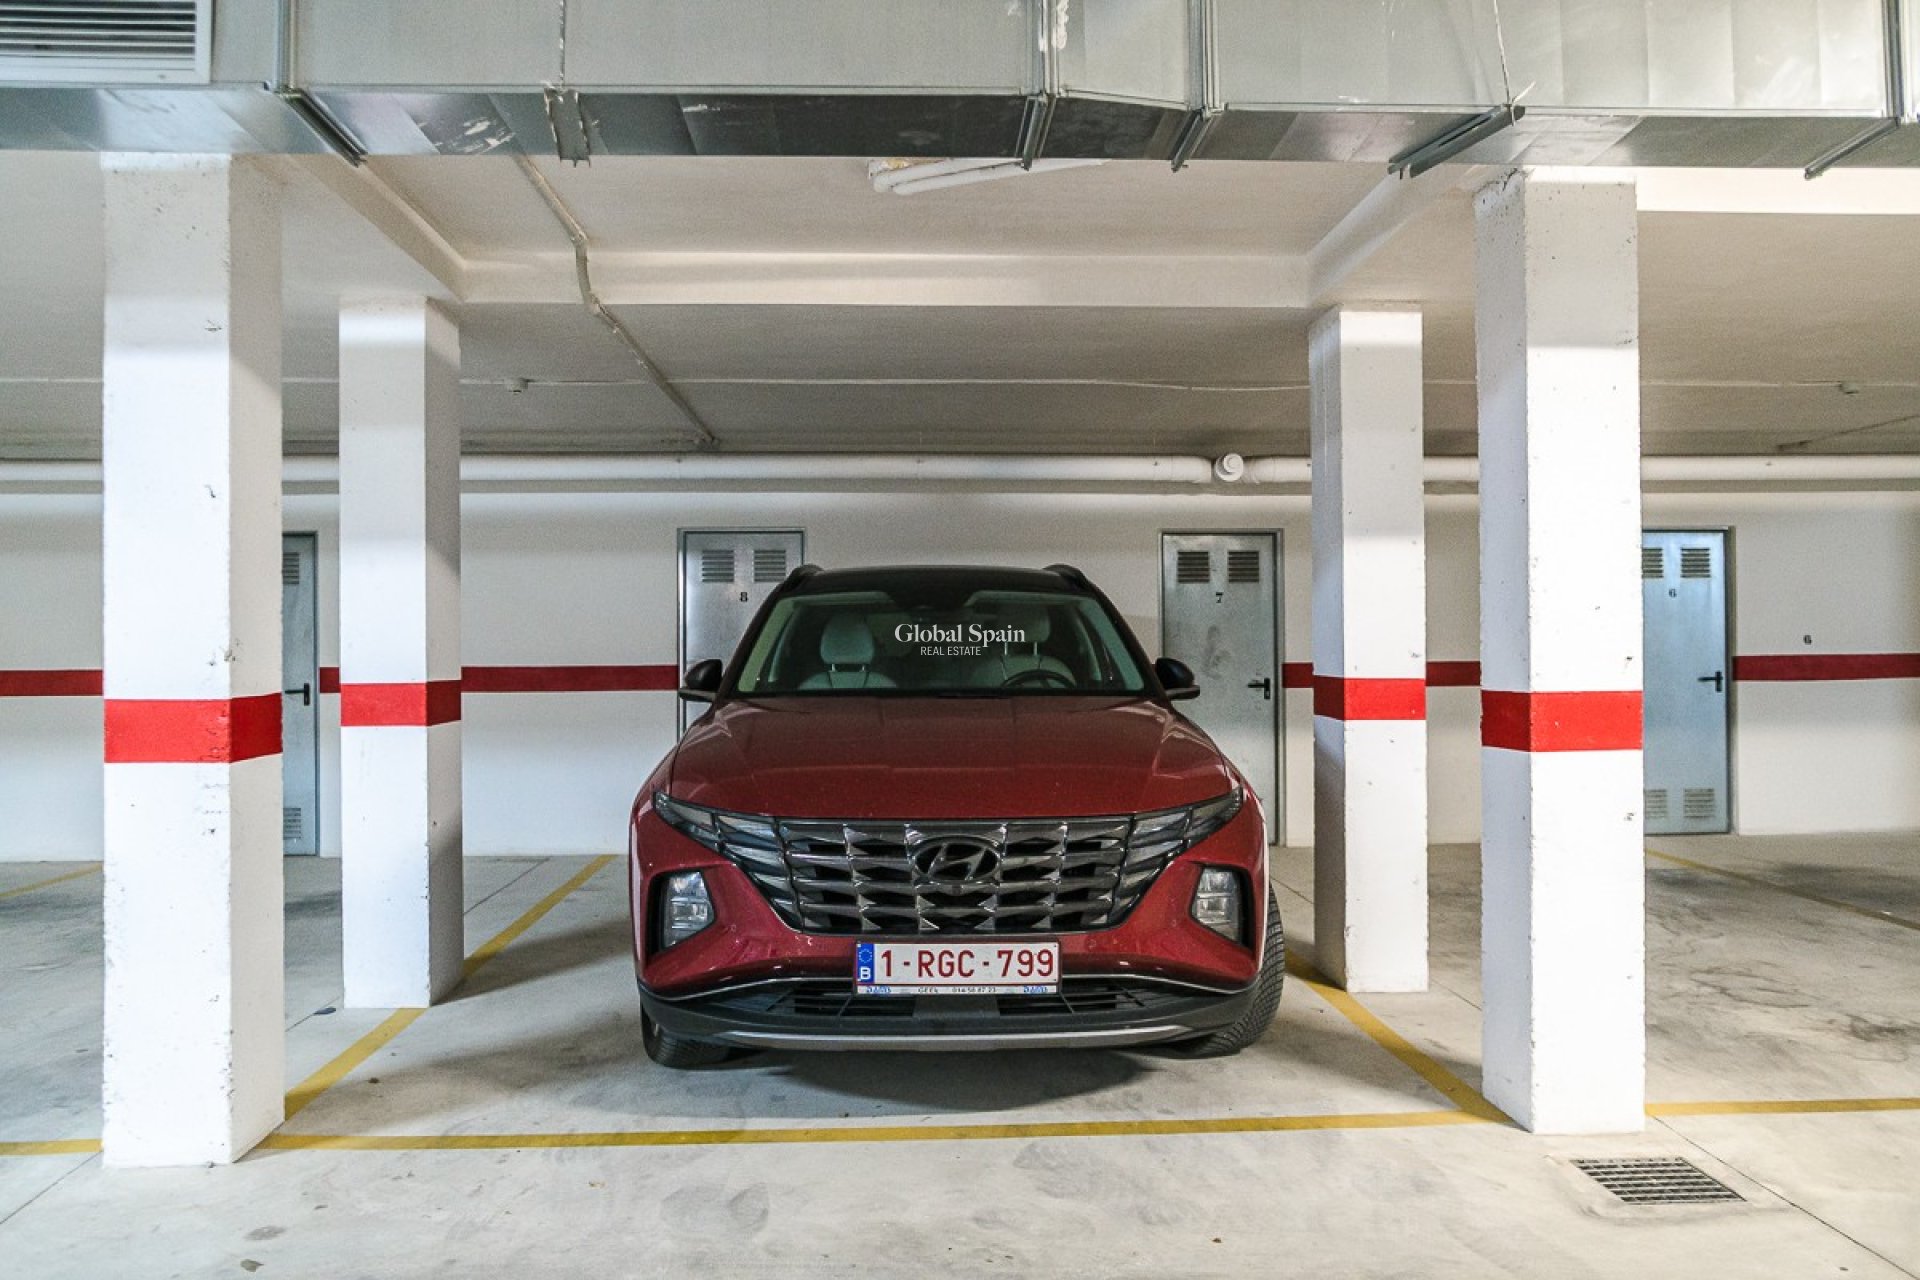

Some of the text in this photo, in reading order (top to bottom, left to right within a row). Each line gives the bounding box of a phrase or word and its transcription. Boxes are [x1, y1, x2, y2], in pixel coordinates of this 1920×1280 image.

[740, 591, 748, 602] 8
[1215, 591, 1224, 603] 7
[881, 949, 1053, 978] 1-RGC-799
[860, 967, 871, 980] B
